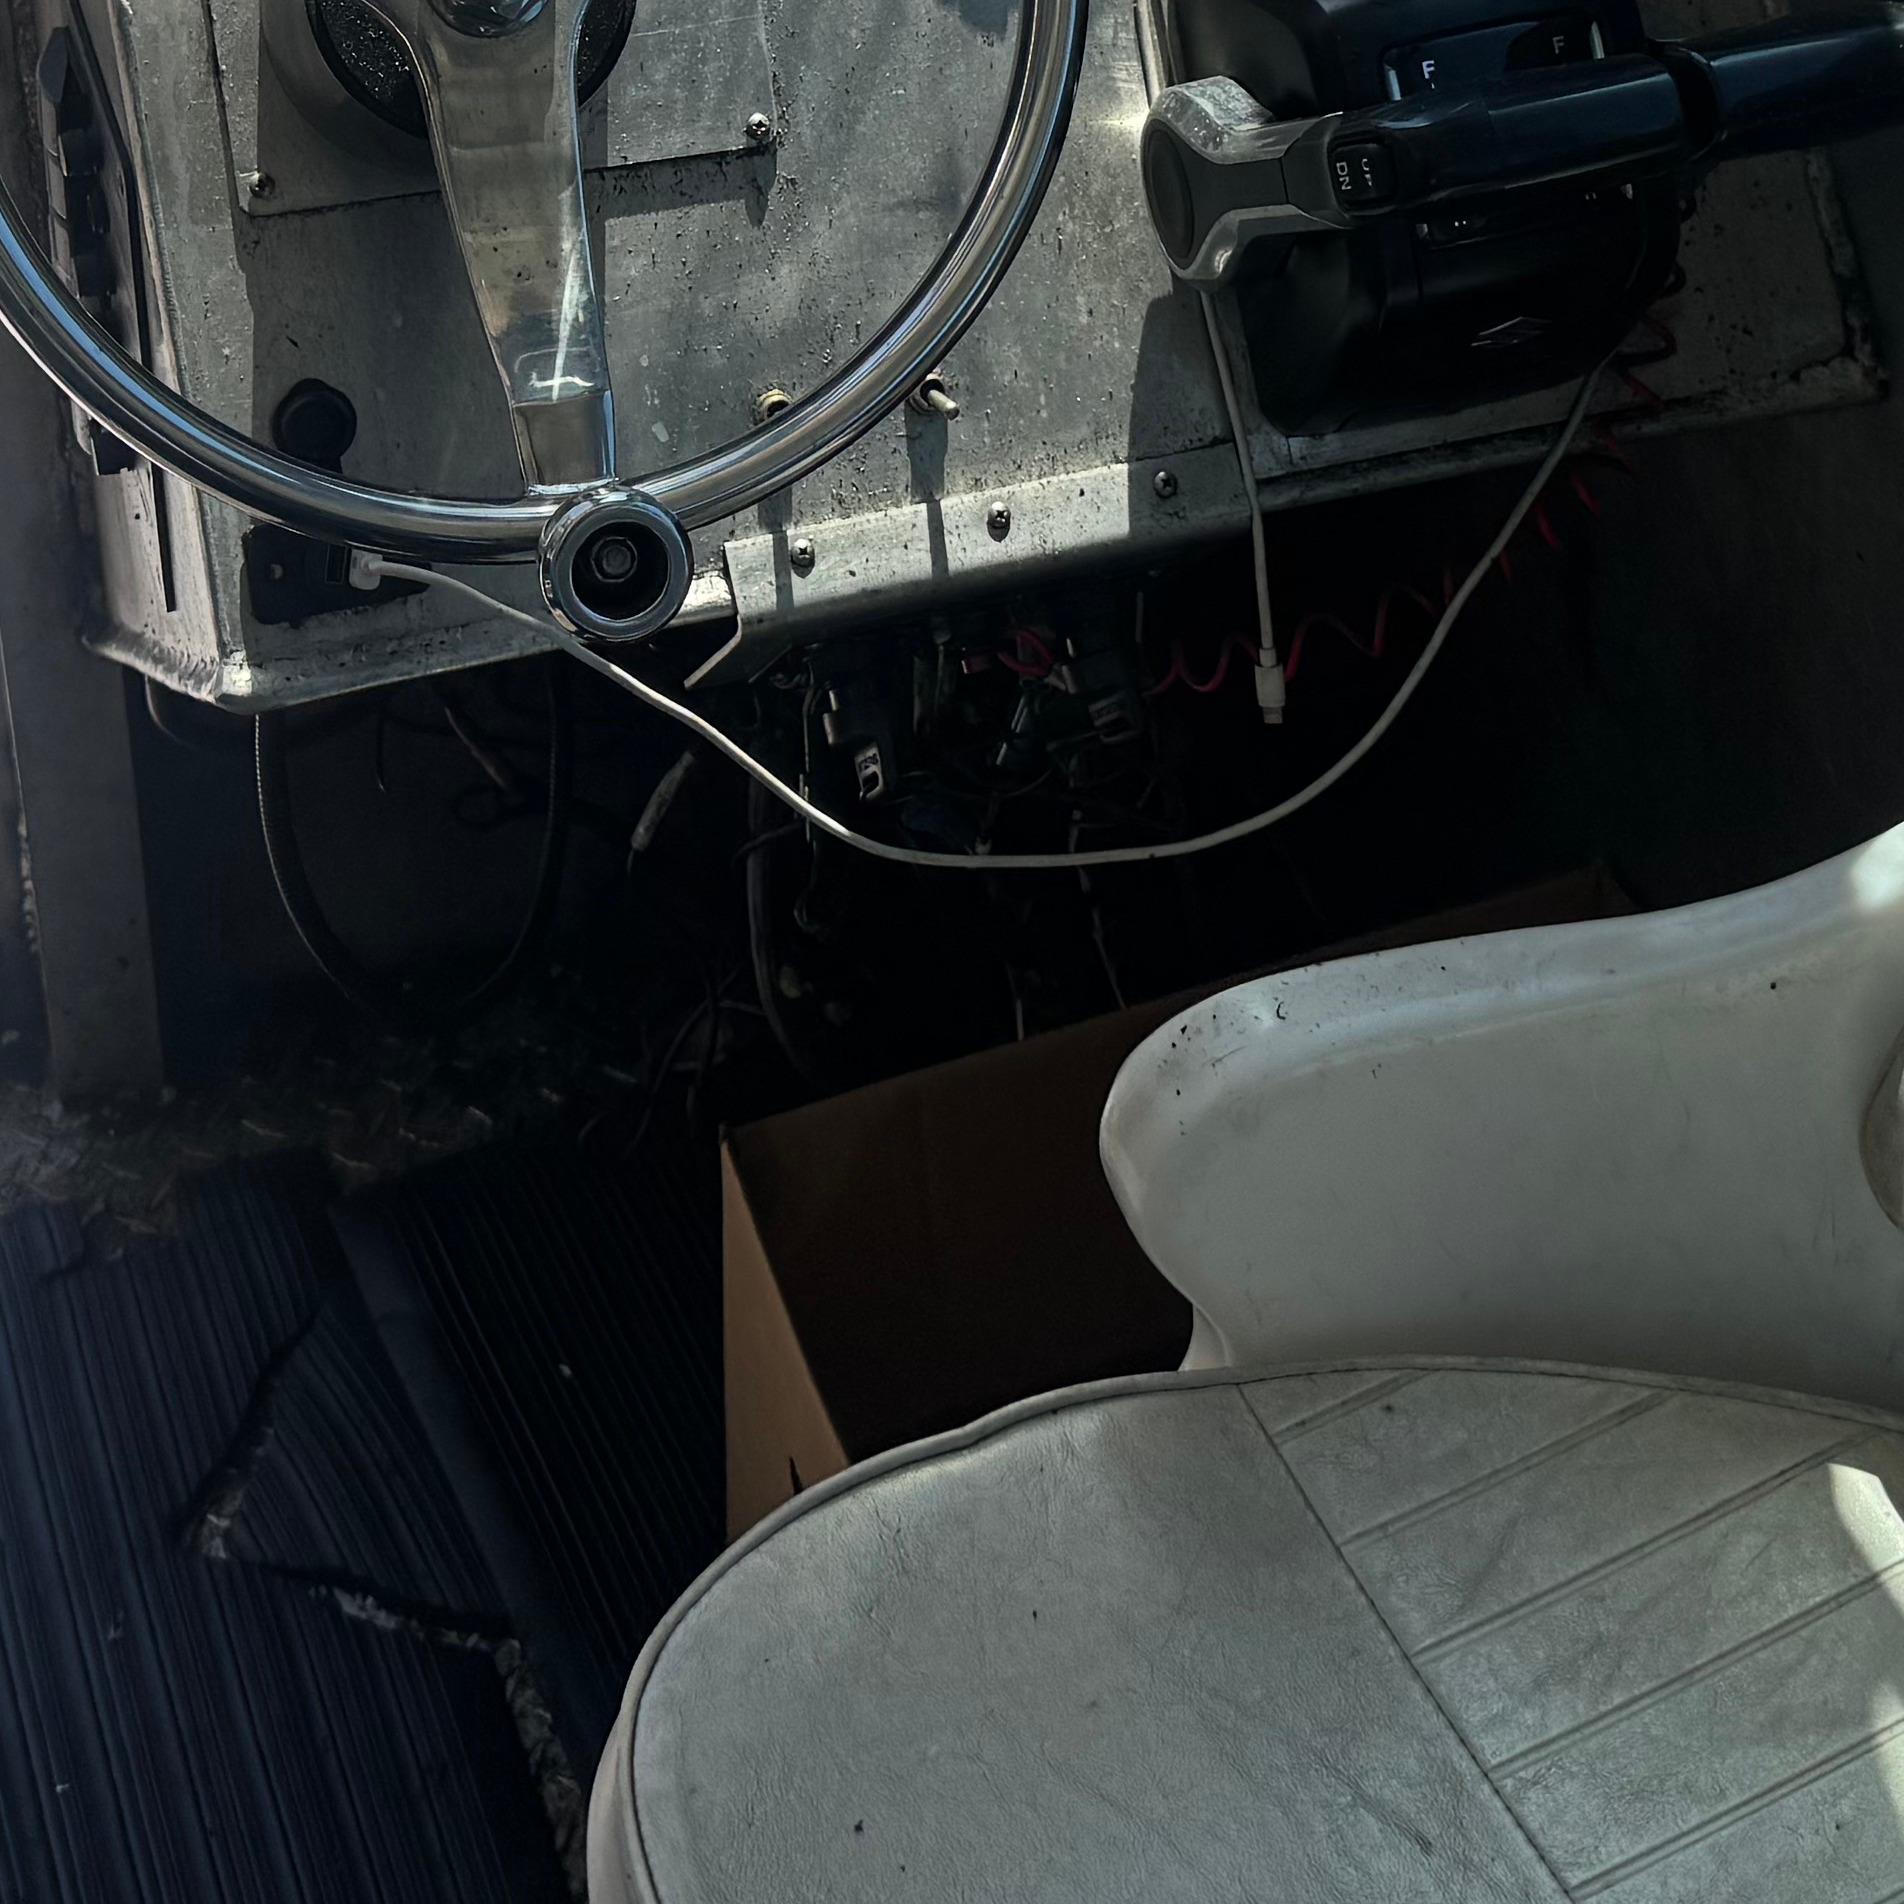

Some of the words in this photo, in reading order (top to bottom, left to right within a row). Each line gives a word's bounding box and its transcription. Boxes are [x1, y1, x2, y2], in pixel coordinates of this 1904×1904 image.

[1551, 34, 1566, 56] F
[1421, 59, 1436, 80] F
[1335, 160, 1352, 192] DN
